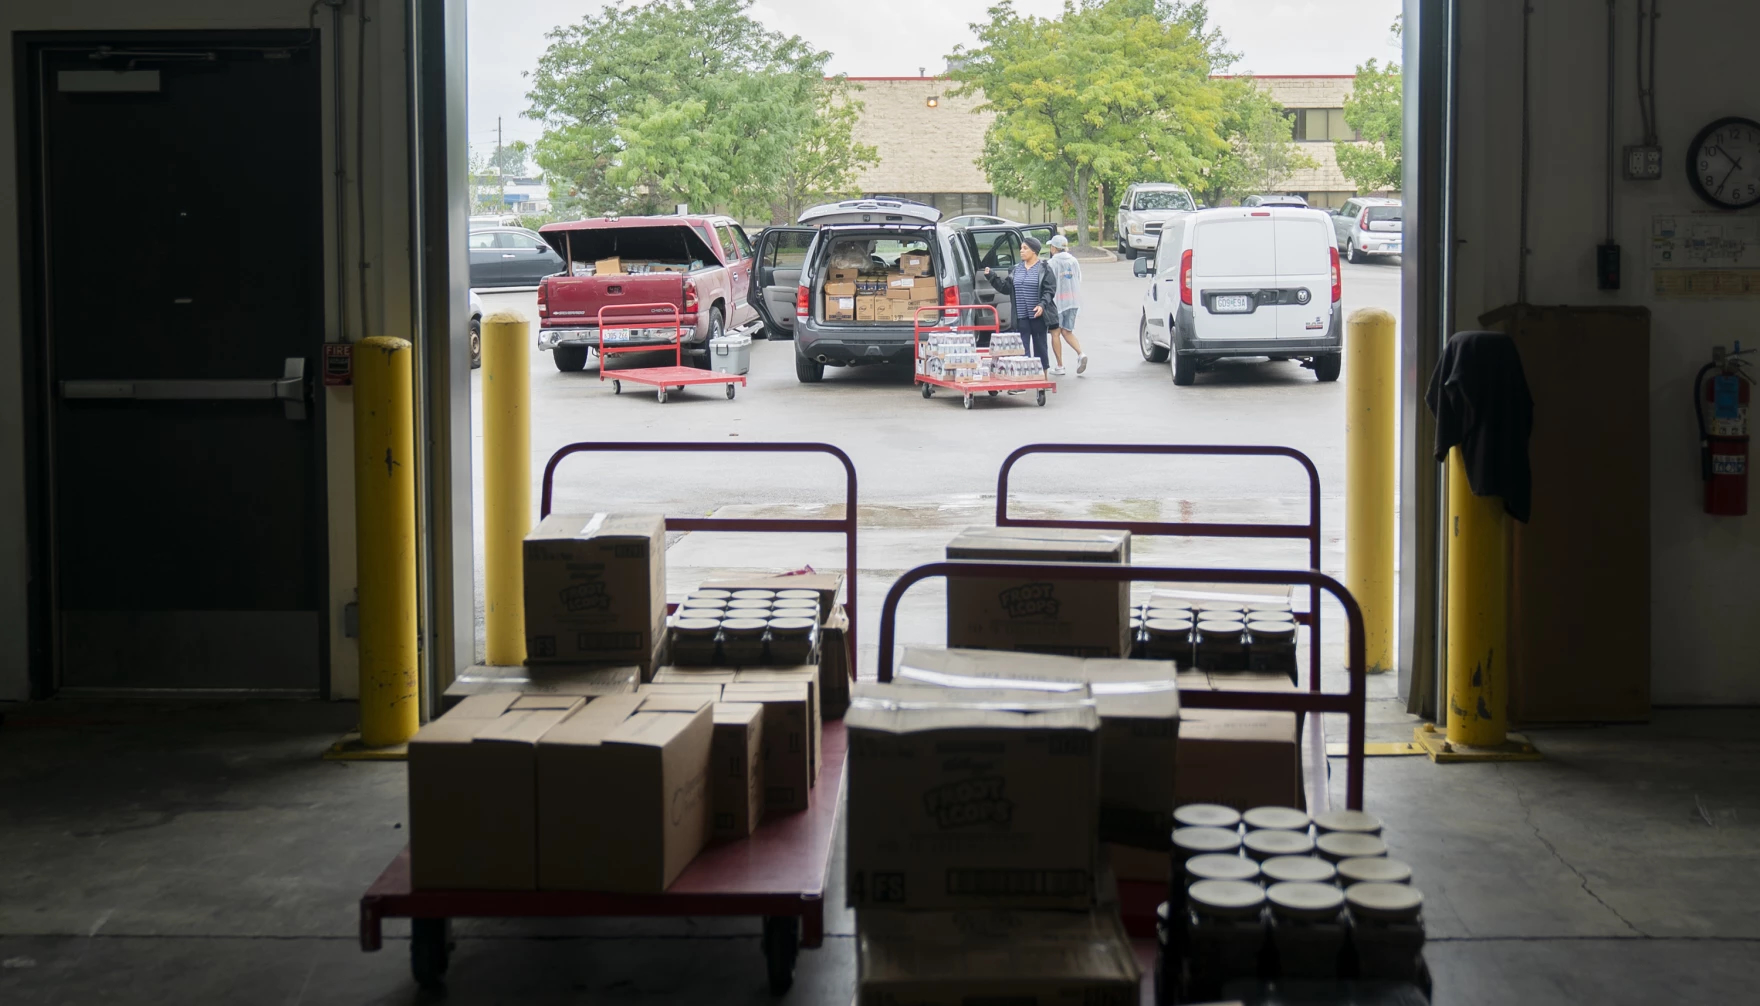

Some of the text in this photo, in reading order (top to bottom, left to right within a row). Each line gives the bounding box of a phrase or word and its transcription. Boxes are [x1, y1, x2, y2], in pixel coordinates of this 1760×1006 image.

[1716, 133, 1724, 144] 11
[1728, 128, 1740, 139] 12
[1747, 132, 1752, 143] 1
[1704, 146, 1717, 157] 10
[1700, 161, 1708, 171] 9
[1705, 175, 1713, 186] 8
[1732, 188, 1740, 199] 6
[1747, 184, 1755, 194] 5
[326, 346, 350, 356] FIRE
[1000, 584, 1054, 607] FROOT
[1010, 600, 1060, 617] LOOPS
[875, 874, 903, 900] FS
